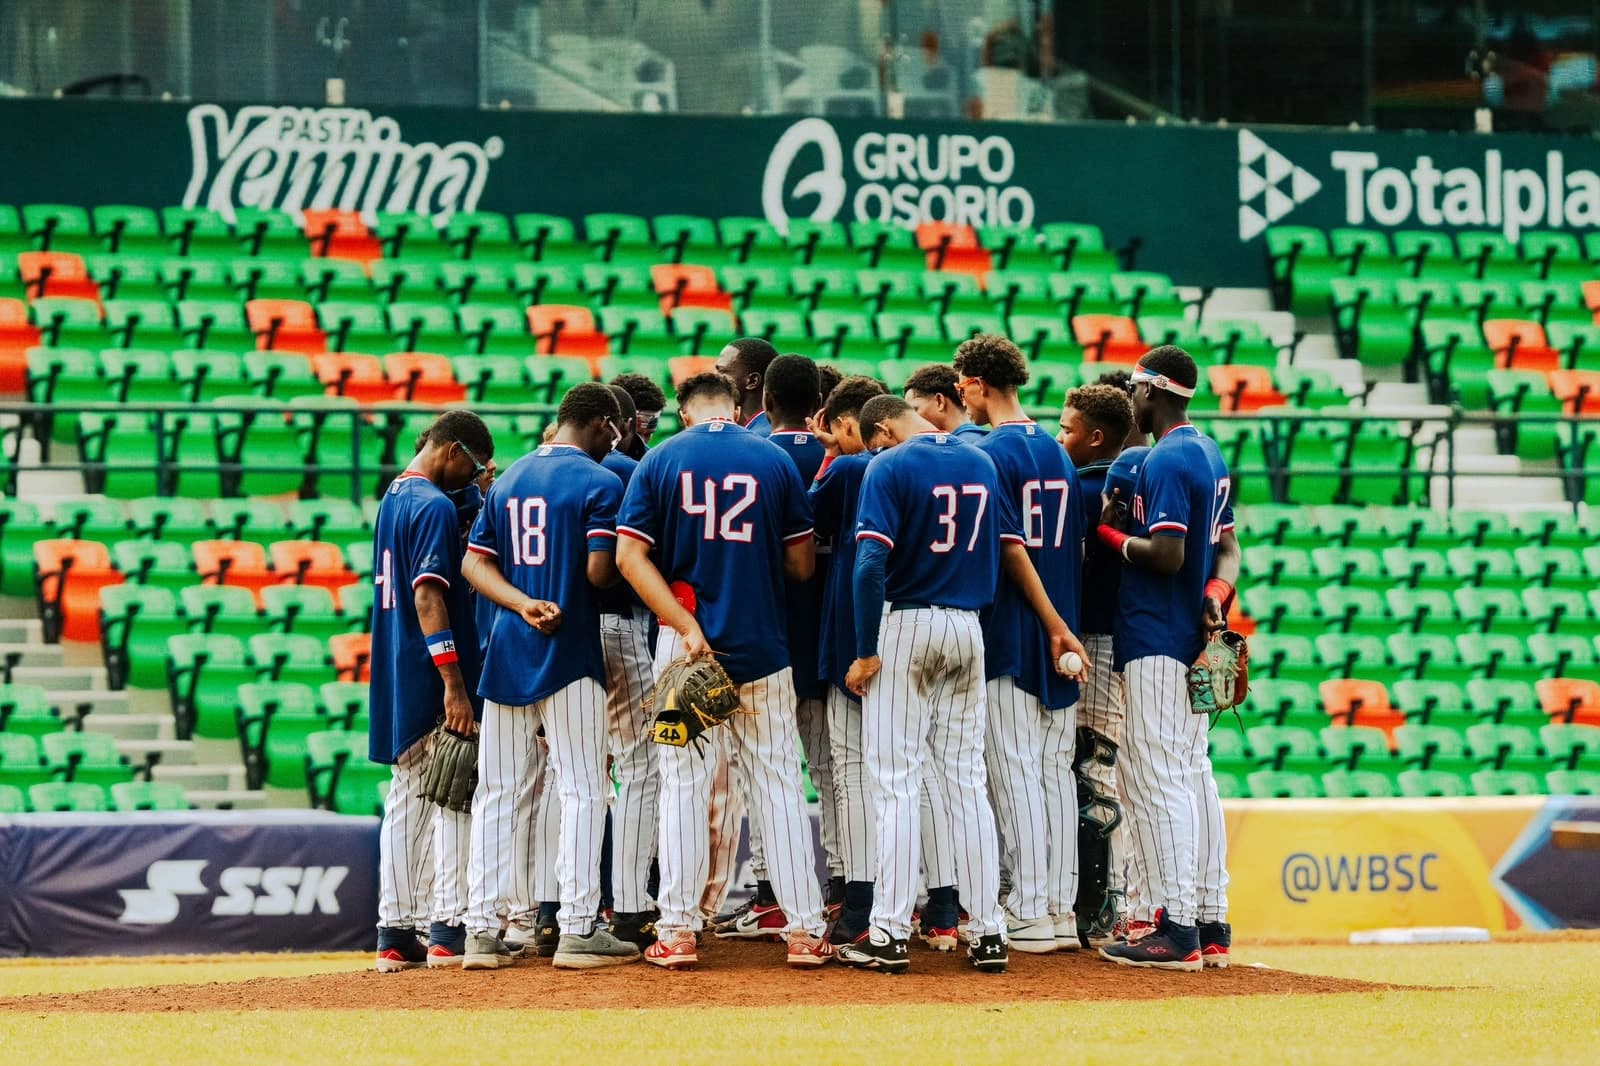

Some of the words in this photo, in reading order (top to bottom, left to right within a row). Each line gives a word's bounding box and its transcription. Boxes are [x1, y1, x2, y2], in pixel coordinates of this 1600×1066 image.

[279, 116, 366, 142] PASTA
[853, 132, 1015, 183] GRUPO
[183, 104, 489, 228] Yemina
[1331, 149, 1600, 244] Totalpla
[853, 183, 1035, 230] OSORIO
[505, 496, 547, 567] 18
[680, 471, 758, 542] 42
[929, 484, 988, 552] 37
[1022, 479, 1069, 548] 67
[211, 866, 349, 916] SSK
[1281, 853, 1439, 903] @WBSC
